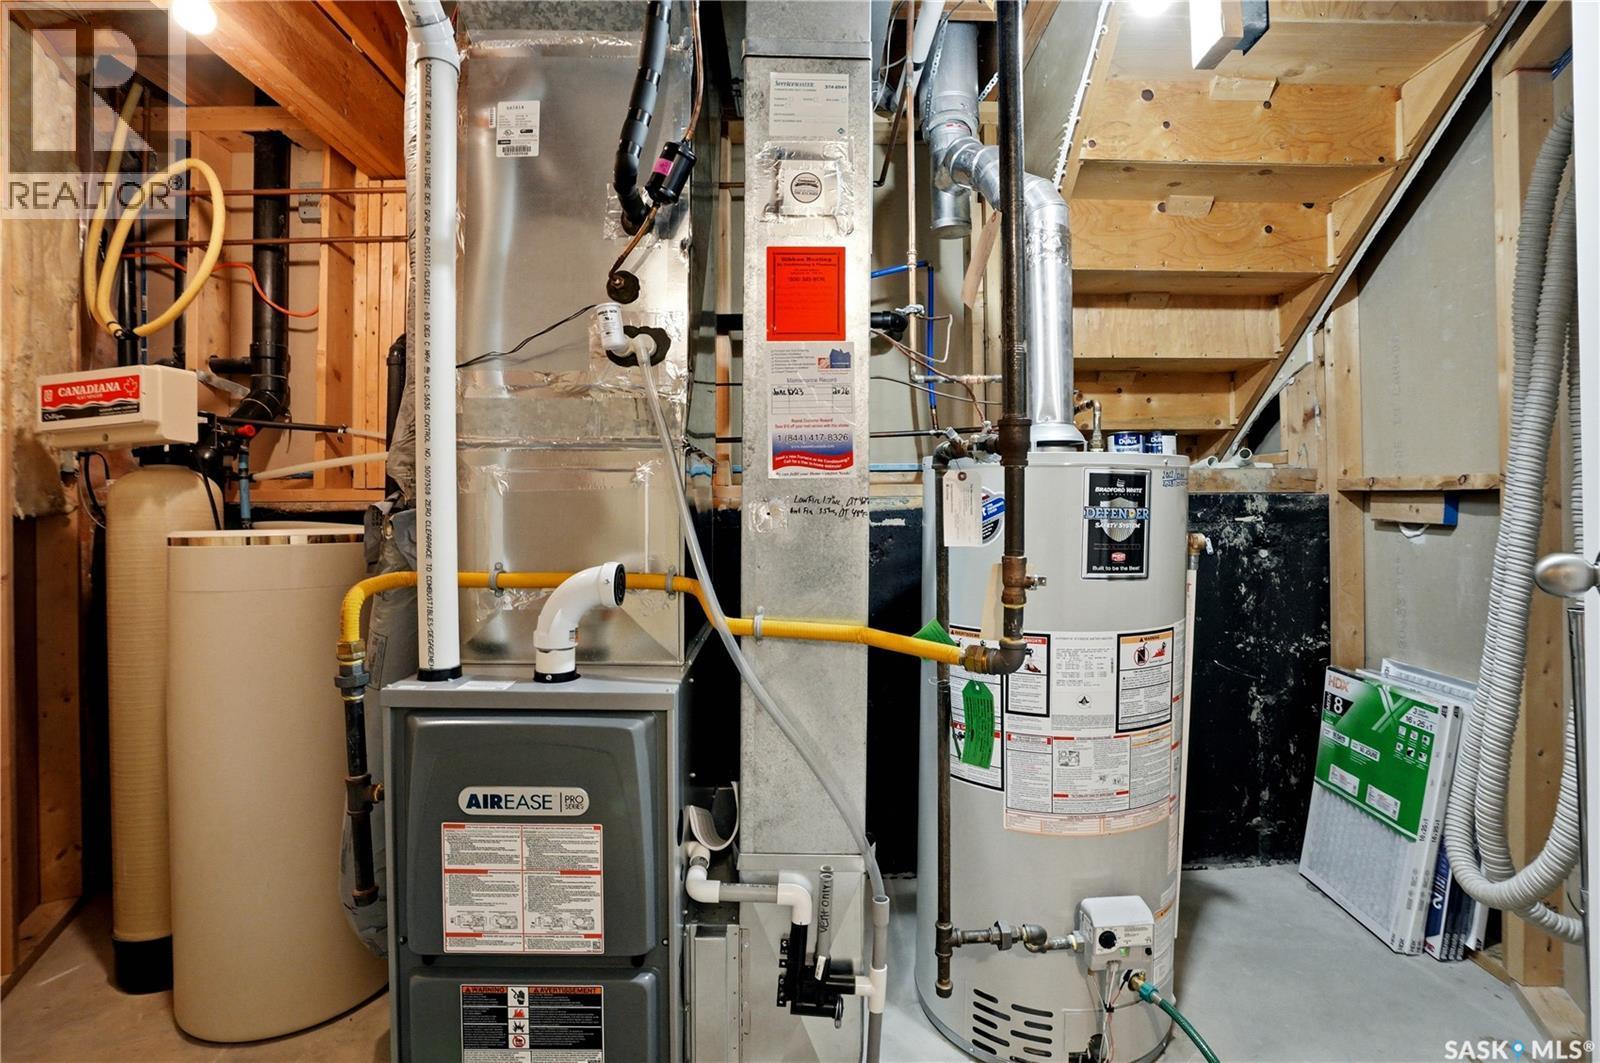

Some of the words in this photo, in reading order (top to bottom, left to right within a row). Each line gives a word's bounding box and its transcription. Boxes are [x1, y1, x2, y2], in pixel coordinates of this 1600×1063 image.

[425, 101, 432, 110] DE
[58, 382, 121, 397] CANADIANA
[784, 433, 807, 442] (844)
[808, 433, 849, 441] 417-8326
[1119, 437, 1138, 445] Dulux
[1084, 507, 1150, 519] DEFENDER
[426, 564, 433, 573] TO
[1328, 675, 1349, 693] HDX
[1333, 697, 1343, 714] 8
[1405, 715, 1413, 723] 16
[1416, 719, 1426, 728] 25
[466, 793, 553, 810] AIREASE
[564, 795, 584, 803] PRO
